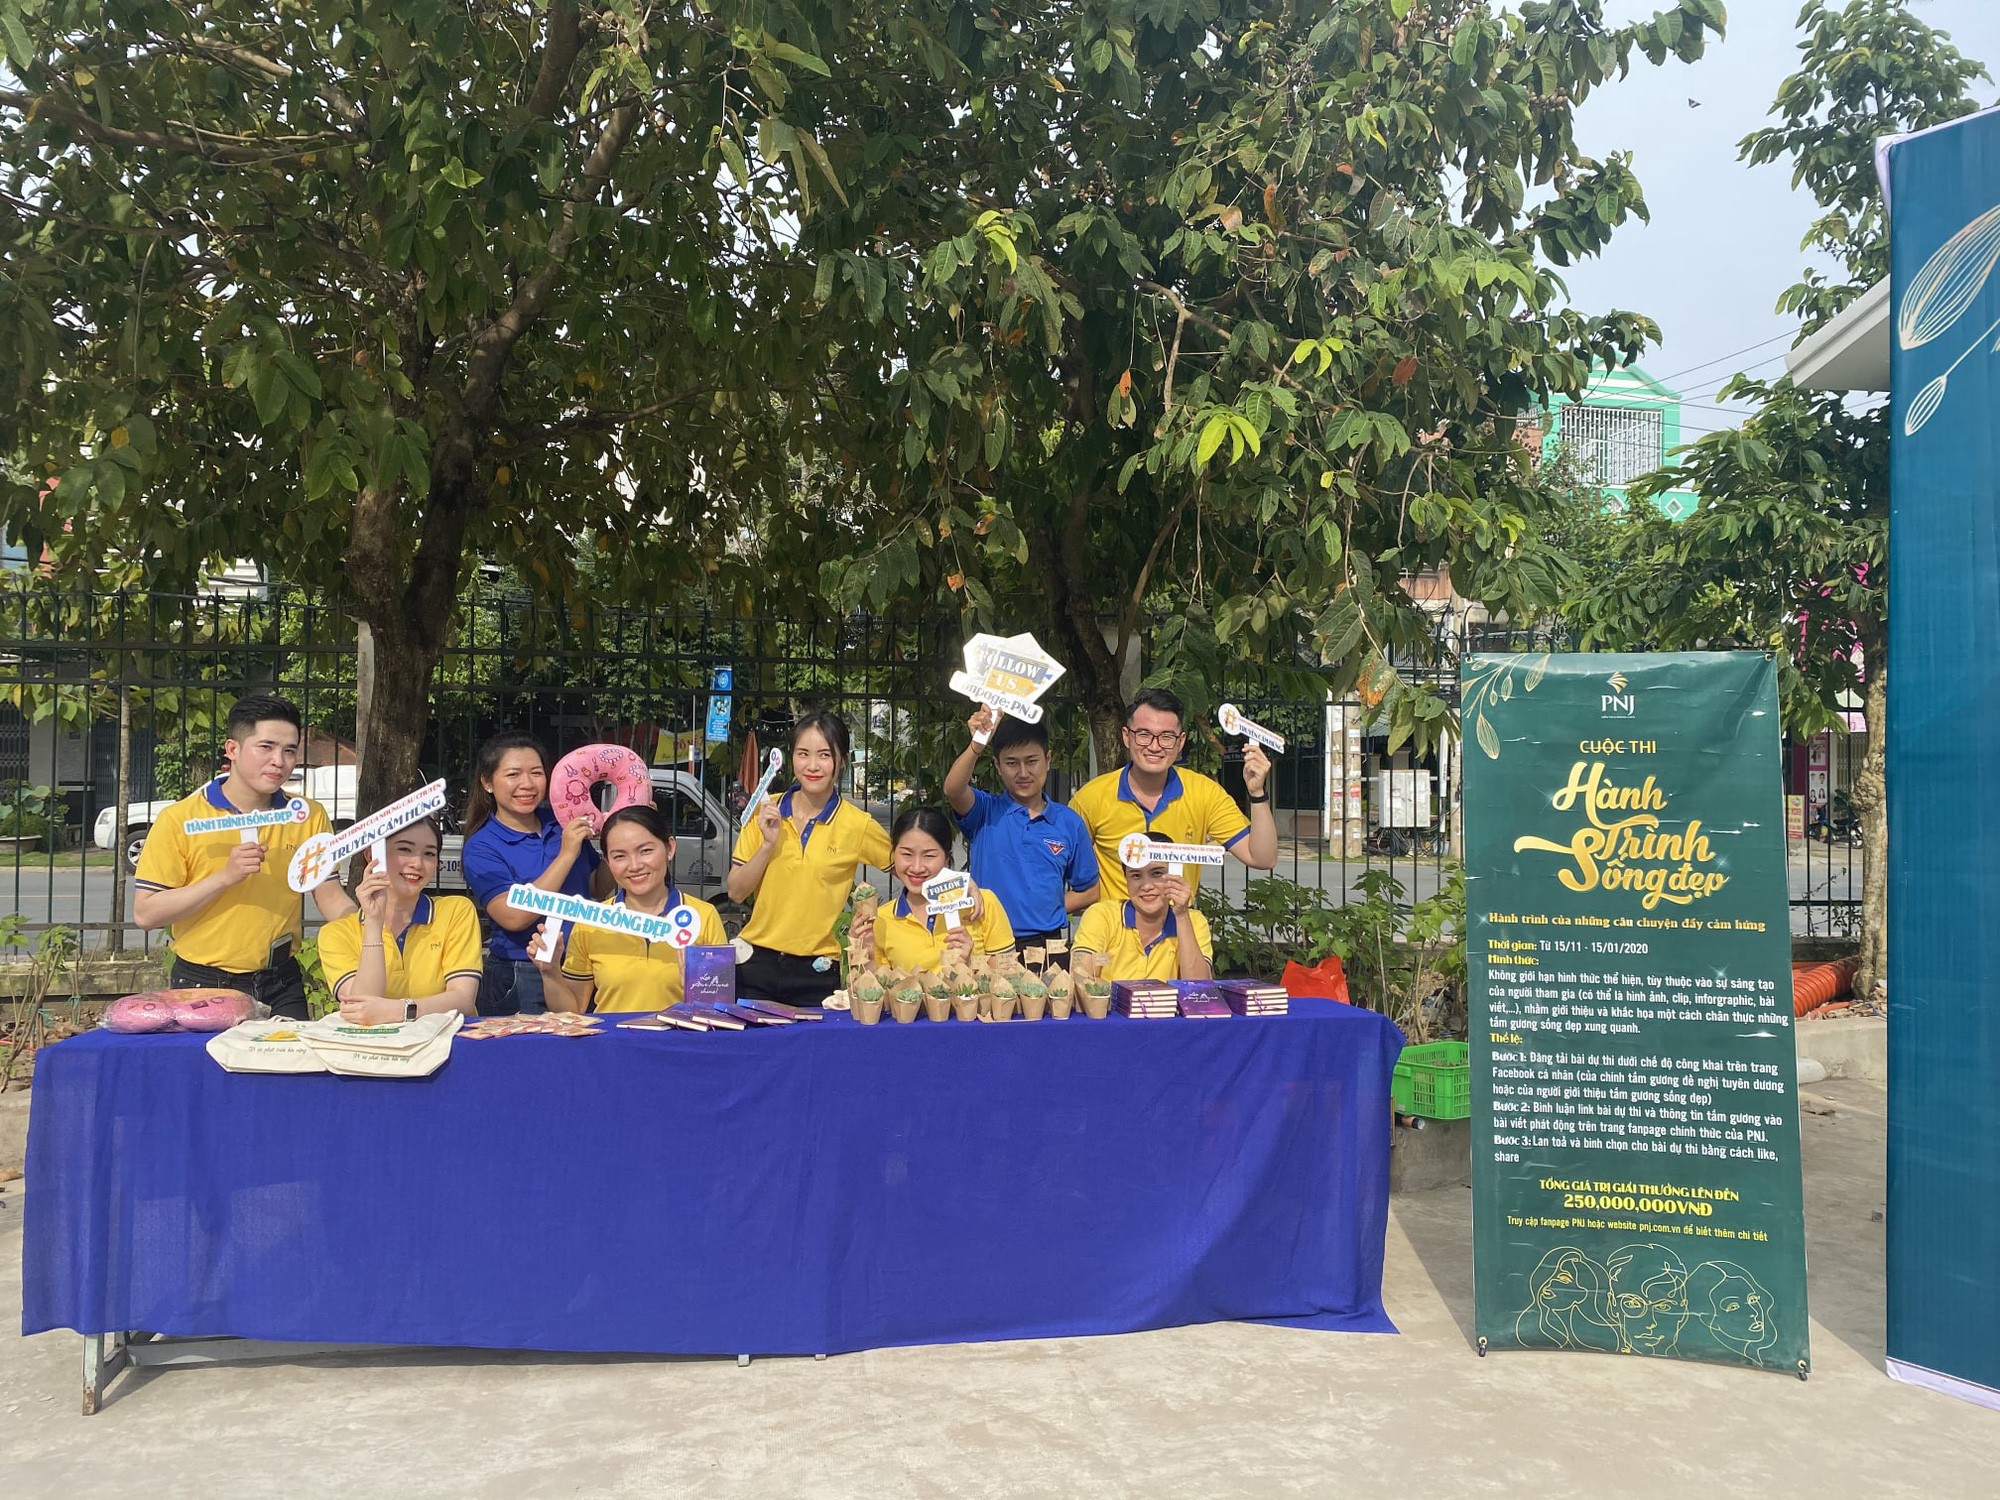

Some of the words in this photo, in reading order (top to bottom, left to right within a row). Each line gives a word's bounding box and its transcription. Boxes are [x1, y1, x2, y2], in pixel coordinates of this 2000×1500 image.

[996, 674, 1018, 691] US
[1012, 700, 1040, 719] PNJ
[1601, 694, 1636, 716] PNJ
[1579, 738, 1625, 756] CUỘC
[1629, 740, 1656, 754] THI
[1552, 761, 1667, 830] Hành
[186, 819, 216, 833] HÀNH
[216, 816, 245, 830] TRÌNH
[378, 813, 404, 836] CẢM
[405, 795, 441, 821] HỨNG
[1593, 820, 1715, 862] Trình
[1514, 827, 1693, 910] Sống
[1668, 862, 1730, 898] đẹp
[929, 880, 961, 896] FOLLOW
[511, 888, 554, 915] HÀNH
[556, 898, 600, 922] TRÌNH
[600, 906, 642, 932] SỐNG
[642, 919, 672, 938] ĐẸP
[1489, 912, 1518, 923] Hành
[1521, 914, 1548, 924] trình
[1551, 914, 1571, 925] của
[1574, 915, 1610, 928] những
[1613, 917, 1633, 926] câu
[1636, 917, 1678, 929] chuyện
[1706, 919, 1731, 929] cảm
[1488, 939, 1510, 950] Thời
[1511, 942, 1537, 952] gian:
[1539, 940, 1551, 950] Từ
[1554, 940, 1580, 951] 15/11
[1591, 942, 1648, 954] 15/01/2020
[1488, 954, 1512, 964] Hình
[1514, 955, 1539, 965] thức:
[1488, 969, 1516, 982] Không
[1519, 970, 1535, 983] giới
[1538, 971, 1554, 983] hạn
[1558, 972, 1576, 982] hình
[1579, 972, 1600, 983] thức
[1603, 971, 1618, 984] thể
[1621, 974, 1643, 986] hiện,
[1646, 975, 1662, 988] tùy
[1665, 975, 1692, 988] thuộc
[1694, 976, 1712, 987] vào
[1715, 978, 1727, 990] sự
[1730, 977, 1755, 991] sáng
[1757, 978, 1774, 991] tạo
[1488, 984, 1505, 996] của
[1508, 987, 1532, 999] người
[1535, 987, 1558, 998] tham
[1561, 988, 1575, 1001] gia
[1578, 988, 1593, 1000] (có
[1596, 988, 1611, 1000] thể
[1614, 990, 1623, 1000] là
[1626, 990, 1646, 1001] hình
[1649, 990, 1668, 1004] ảnh,
[1672, 992, 1691, 1005] clip,
[1759, 995, 1774, 1006] bài
[1489, 1015, 1507, 1027] tấm
[1510, 1019, 1537, 1031] gương
[1540, 1017, 1562, 1032] sống
[1565, 1020, 1581, 1033] đẹp
[1584, 1022, 1607, 1034] xung
[1610, 1022, 1640, 1034] quanh.
[1552, 1004, 1568, 1017] giới
[1571, 1005, 1594, 1017] thiệu
[1597, 1006, 1608, 1016] và
[1611, 1006, 1633, 1017] khắc
[1636, 1007, 1654, 1020] họa
[1657, 1008, 1676, 1021] một
[1679, 1009, 1702, 1020] cách
[1705, 1010, 1729, 1021] chân
[1732, 1011, 1754, 1024] thực
[1758, 1012, 1788, 1026] những
[1510, 1033, 1522, 1044] lệ:
[1492, 1051, 1517, 1061] Bước
[1519, 1052, 1526, 1061] 1:
[1530, 1051, 1553, 1065] Đăng
[1571, 1053, 1584, 1064] bài
[1588, 1054, 1599, 1066] dự
[1602, 1054, 1614, 1065] thi
[1618, 1055, 1637, 1066] dưới
[1640, 1056, 1657, 1067] chế
[1660, 1057, 1672, 1070] độ
[1676, 1058, 1700, 1072] công
[1702, 1059, 1723, 1070] khai
[1726, 1060, 1747, 1072] trên
[1750, 1062, 1778, 1076] trang
[1539, 1176, 1570, 1190] TỔNG
[1571, 1179, 1591, 1191] GIÁ
[1612, 1181, 1636, 1193] GIẢI
[1638, 1183, 1690, 1197] THƯỞNG
[1714, 1187, 1739, 1201] ĐẾN
[1507, 1215, 1523, 1227] Truy
[1540, 1216, 1569, 1228] fanpage
[1572, 1218, 1585, 1227] PNJ
[1587, 1219, 1605, 1229] hoặc
[1607, 1221, 1636, 1230] website
[1639, 1223, 1680, 1233] pnj.com.vn
[1714, 1228, 1735, 1238] thêm
[1738, 1230, 1750, 1239] chi
